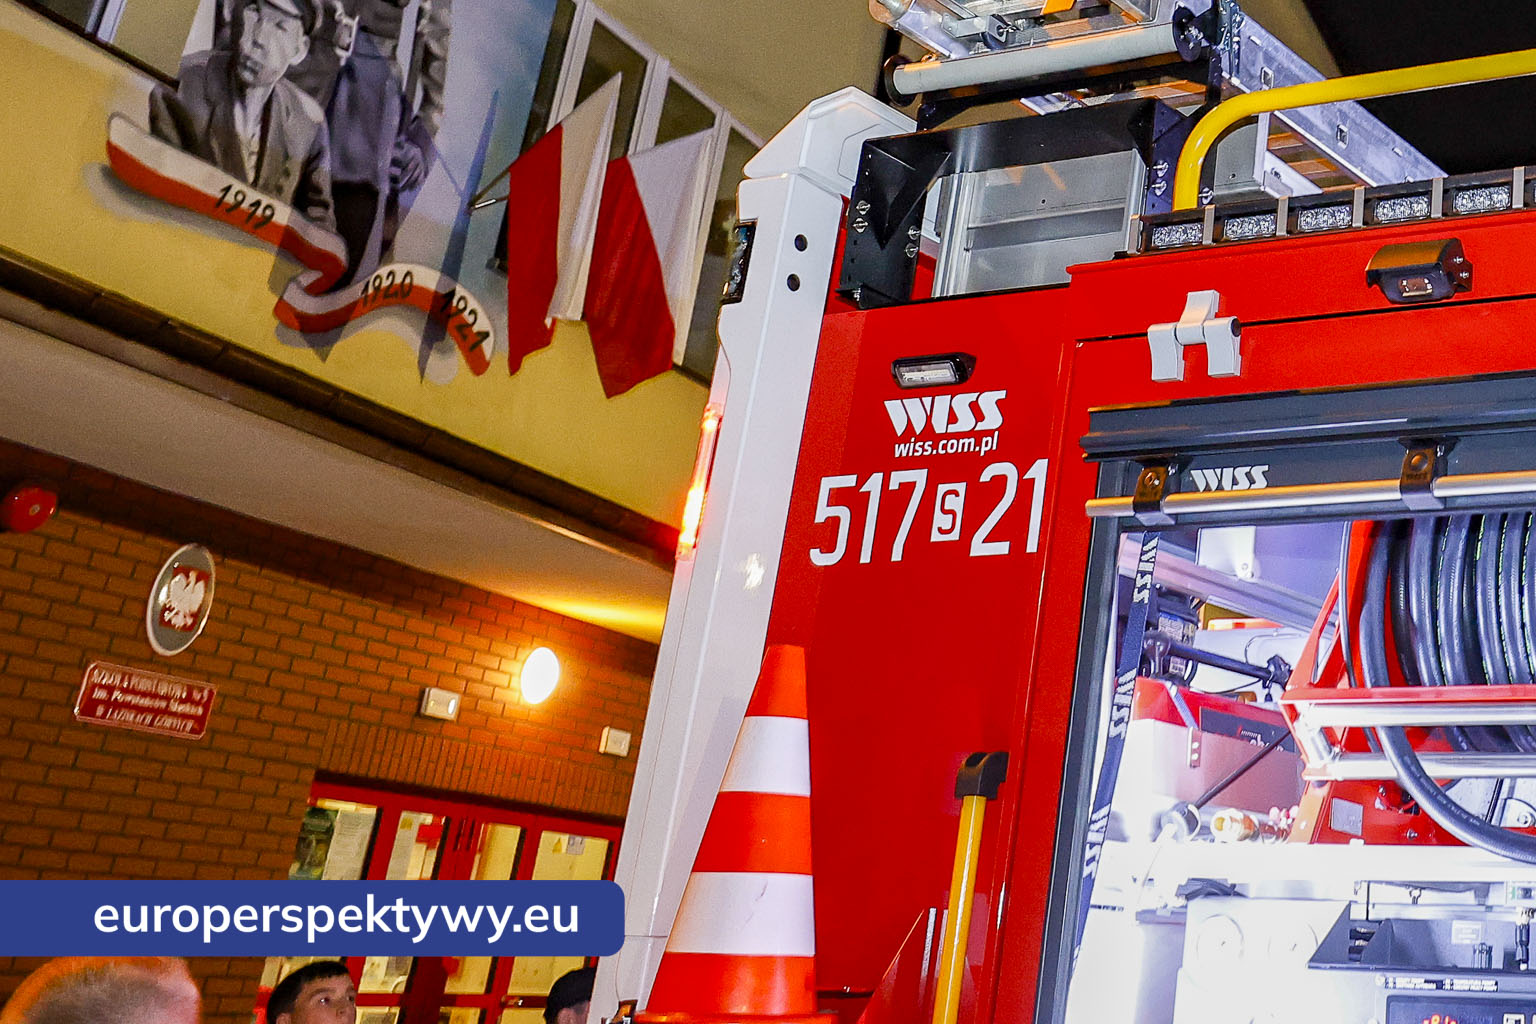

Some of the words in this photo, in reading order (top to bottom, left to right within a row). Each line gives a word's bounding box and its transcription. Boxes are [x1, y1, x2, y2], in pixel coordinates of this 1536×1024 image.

[214, 183, 275, 230] 1919
[360, 270, 414, 308] 1920
[440, 288, 491, 352] 1921
[884, 389, 1007, 437] WISS
[894, 431, 999, 458] wiss.com.pl
[1190, 464, 1269, 493] WISS
